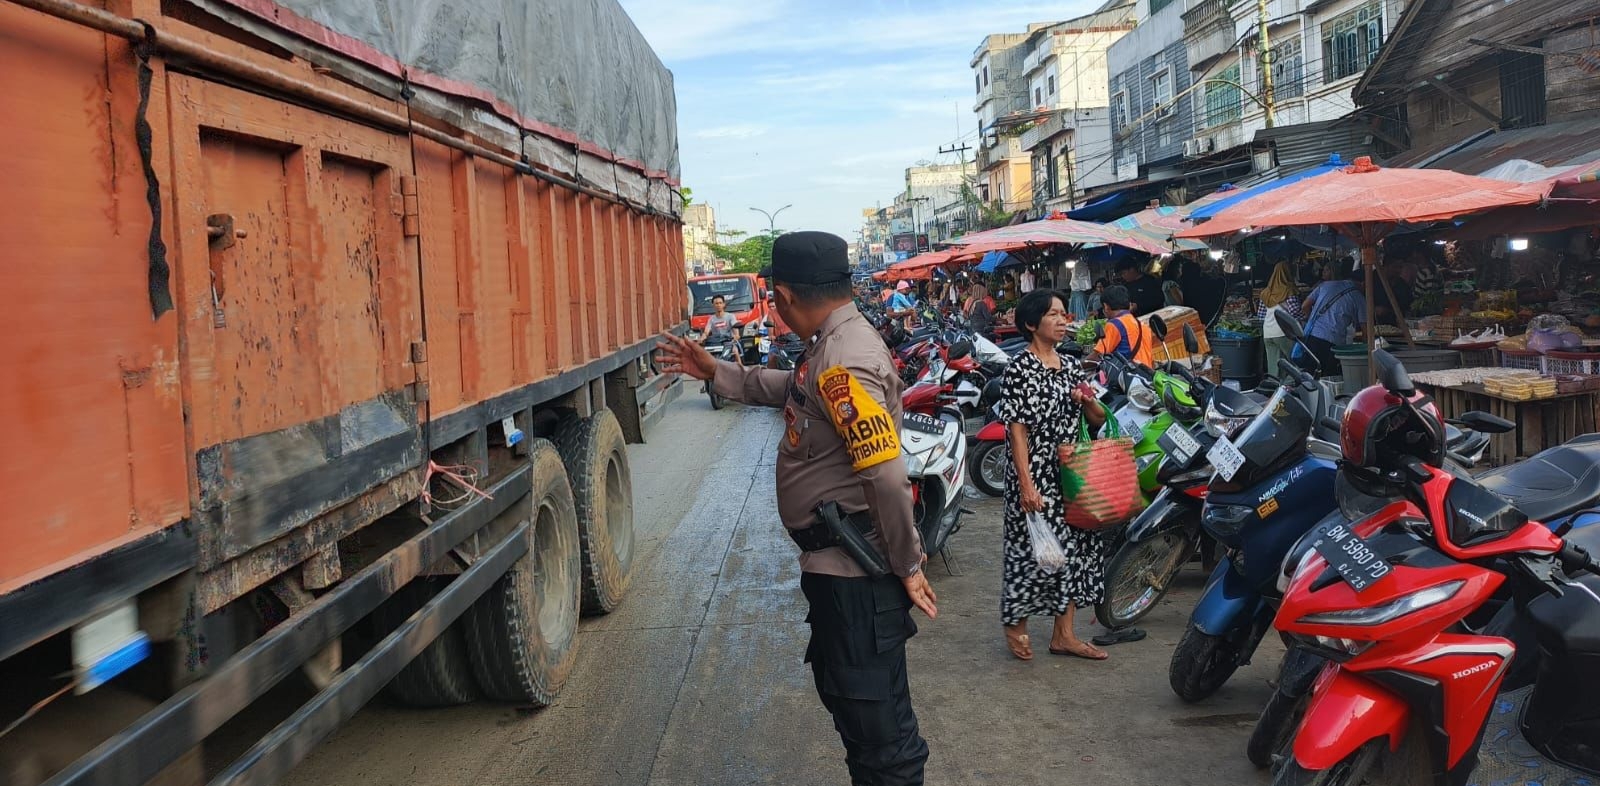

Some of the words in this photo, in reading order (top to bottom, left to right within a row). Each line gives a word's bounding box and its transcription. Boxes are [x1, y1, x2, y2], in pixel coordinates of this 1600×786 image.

[1459, 508, 1487, 526] HONDA
[1326, 524, 1350, 543] BM
[1342, 538, 1375, 565] 5960
[1364, 560, 1389, 578] PD
[1452, 660, 1497, 679] HONDA
